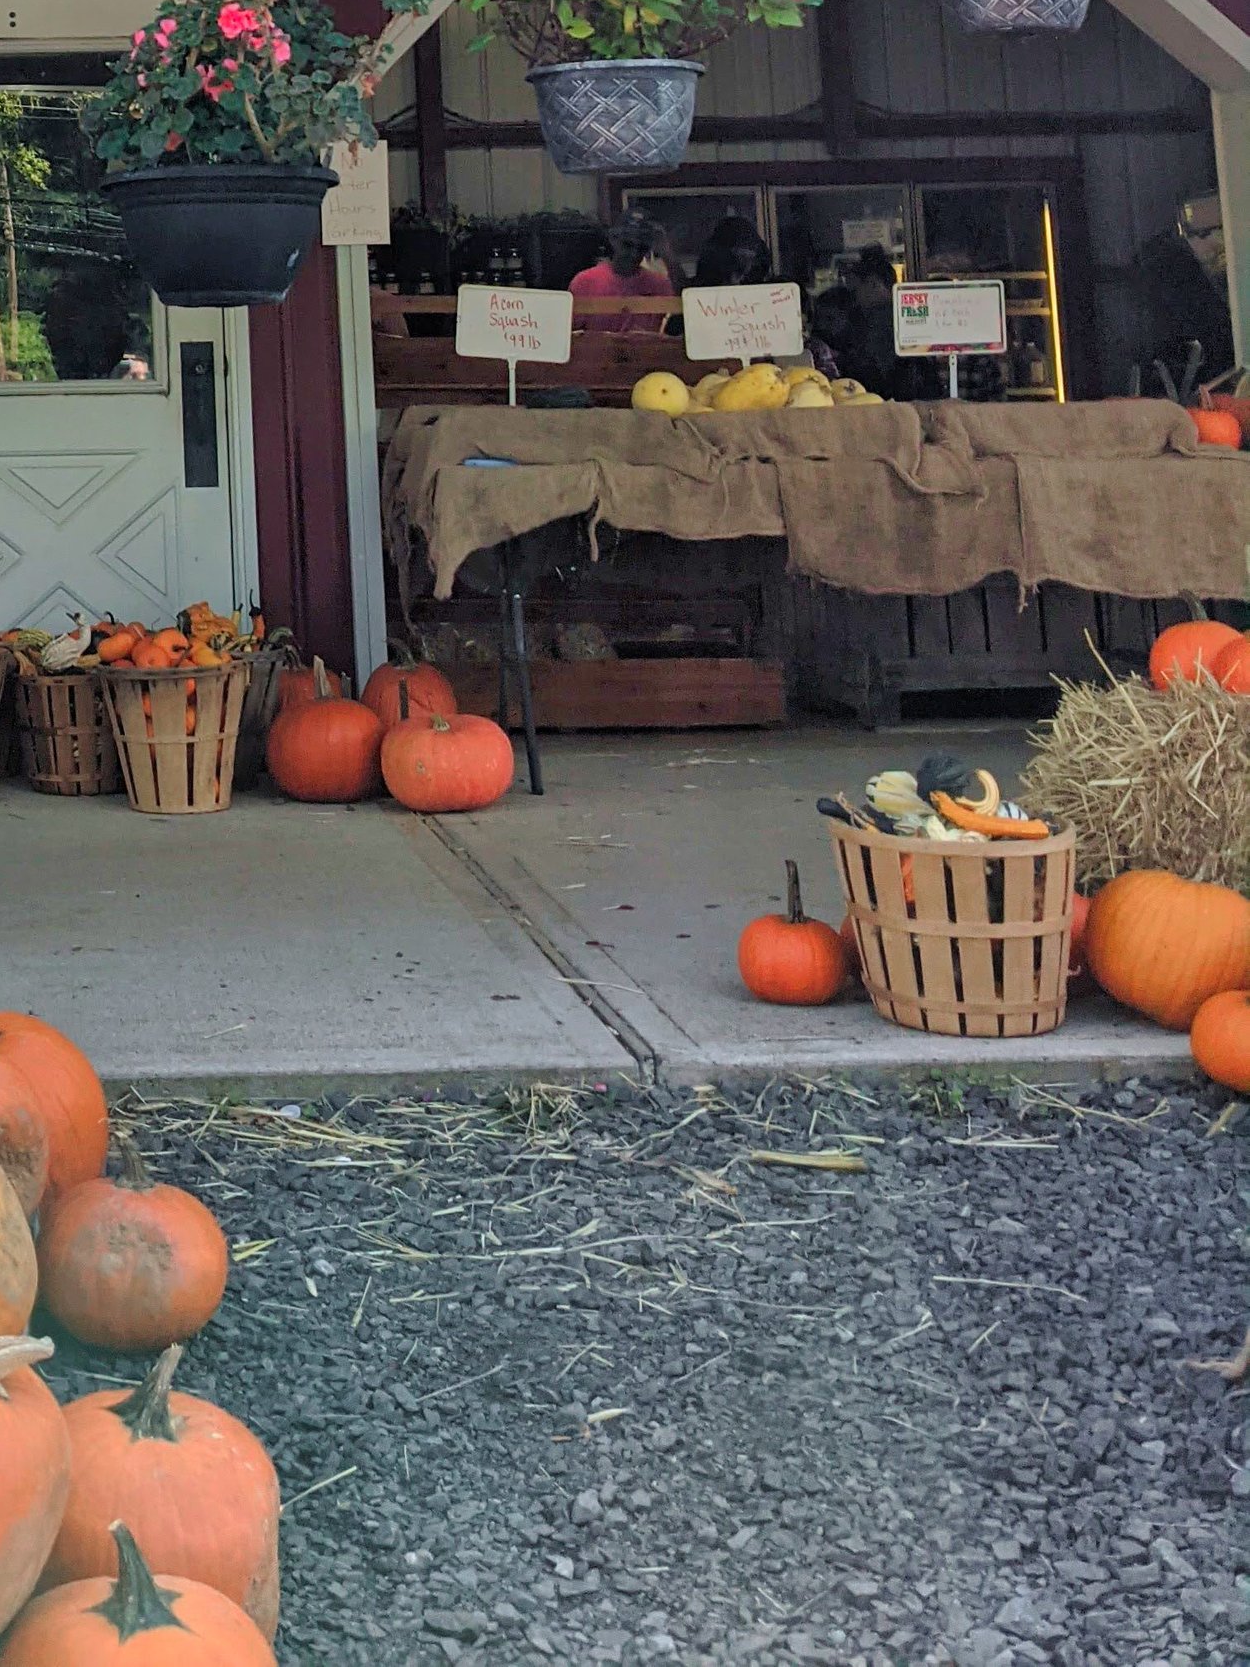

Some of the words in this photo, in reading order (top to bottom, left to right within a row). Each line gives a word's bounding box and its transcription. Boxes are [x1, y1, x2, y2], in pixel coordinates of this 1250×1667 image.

[490, 294, 524, 311] Acorn
[697, 294, 760, 317] Winter
[901, 294, 928, 305] JERSEY
[902, 306, 929, 317] FRESH
[490, 313, 538, 331] Squash
[728, 314, 786, 337] Squash
